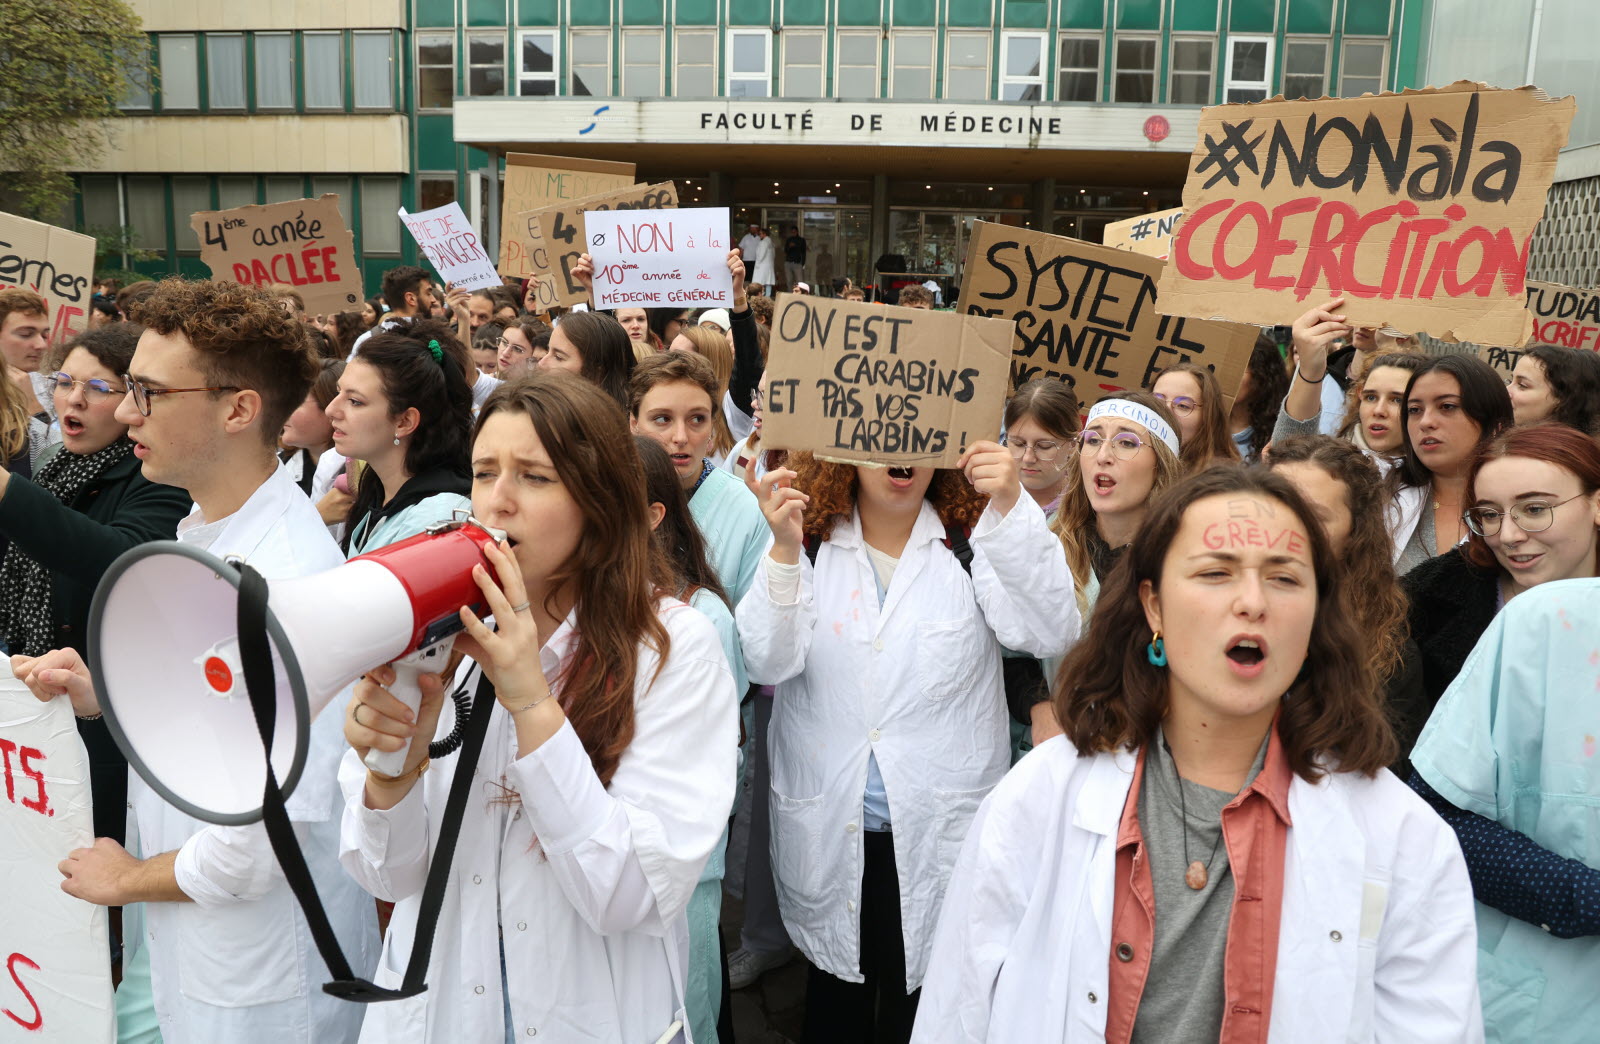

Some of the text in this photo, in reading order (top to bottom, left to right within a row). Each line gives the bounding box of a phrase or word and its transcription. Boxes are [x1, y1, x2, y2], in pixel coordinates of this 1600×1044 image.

[701, 109, 1062, 134] FACULTÉ DE MÉDECINE
[252, 210, 325, 247] année
[617, 222, 674, 254] NON
[687, 236, 696, 249] à
[708, 228, 723, 249] la
[642, 269, 682, 281] année
[696, 269, 712, 280] de
[668, 288, 726, 302] GÉNÉRALE
[780, 301, 913, 354] ON EST
[769, 379, 922, 421] ET PAS VOS
[959, 431, 968, 454] !
[1227, 496, 1276, 519] EN
[1202, 518, 1307, 555] GRÈVE
